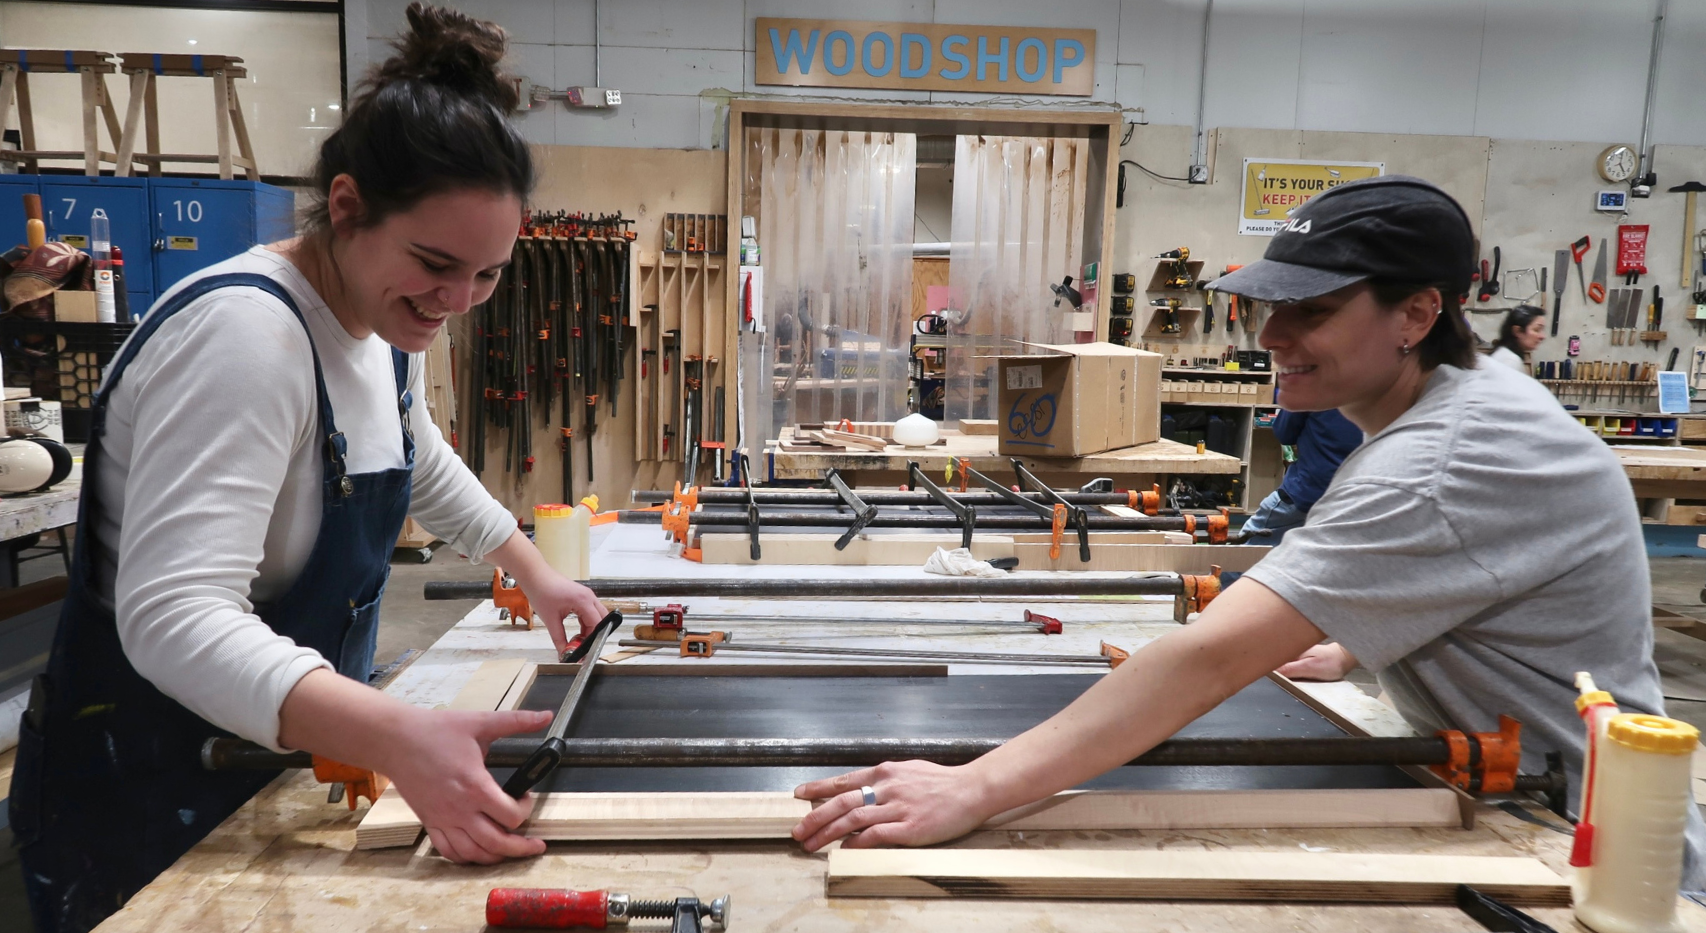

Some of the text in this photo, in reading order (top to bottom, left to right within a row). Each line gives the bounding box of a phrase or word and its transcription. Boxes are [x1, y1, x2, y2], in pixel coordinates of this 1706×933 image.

[768, 28, 1085, 83] WOODSHOP
[1264, 178, 1287, 189] IT'S
[1291, 179, 1324, 190] YOUR
[62, 198, 76, 219] 7
[1262, 194, 1312, 205] KEEP IT
[173, 200, 202, 222] 10
[1279, 218, 1312, 234] FILA
[1008, 393, 1057, 437] 60
